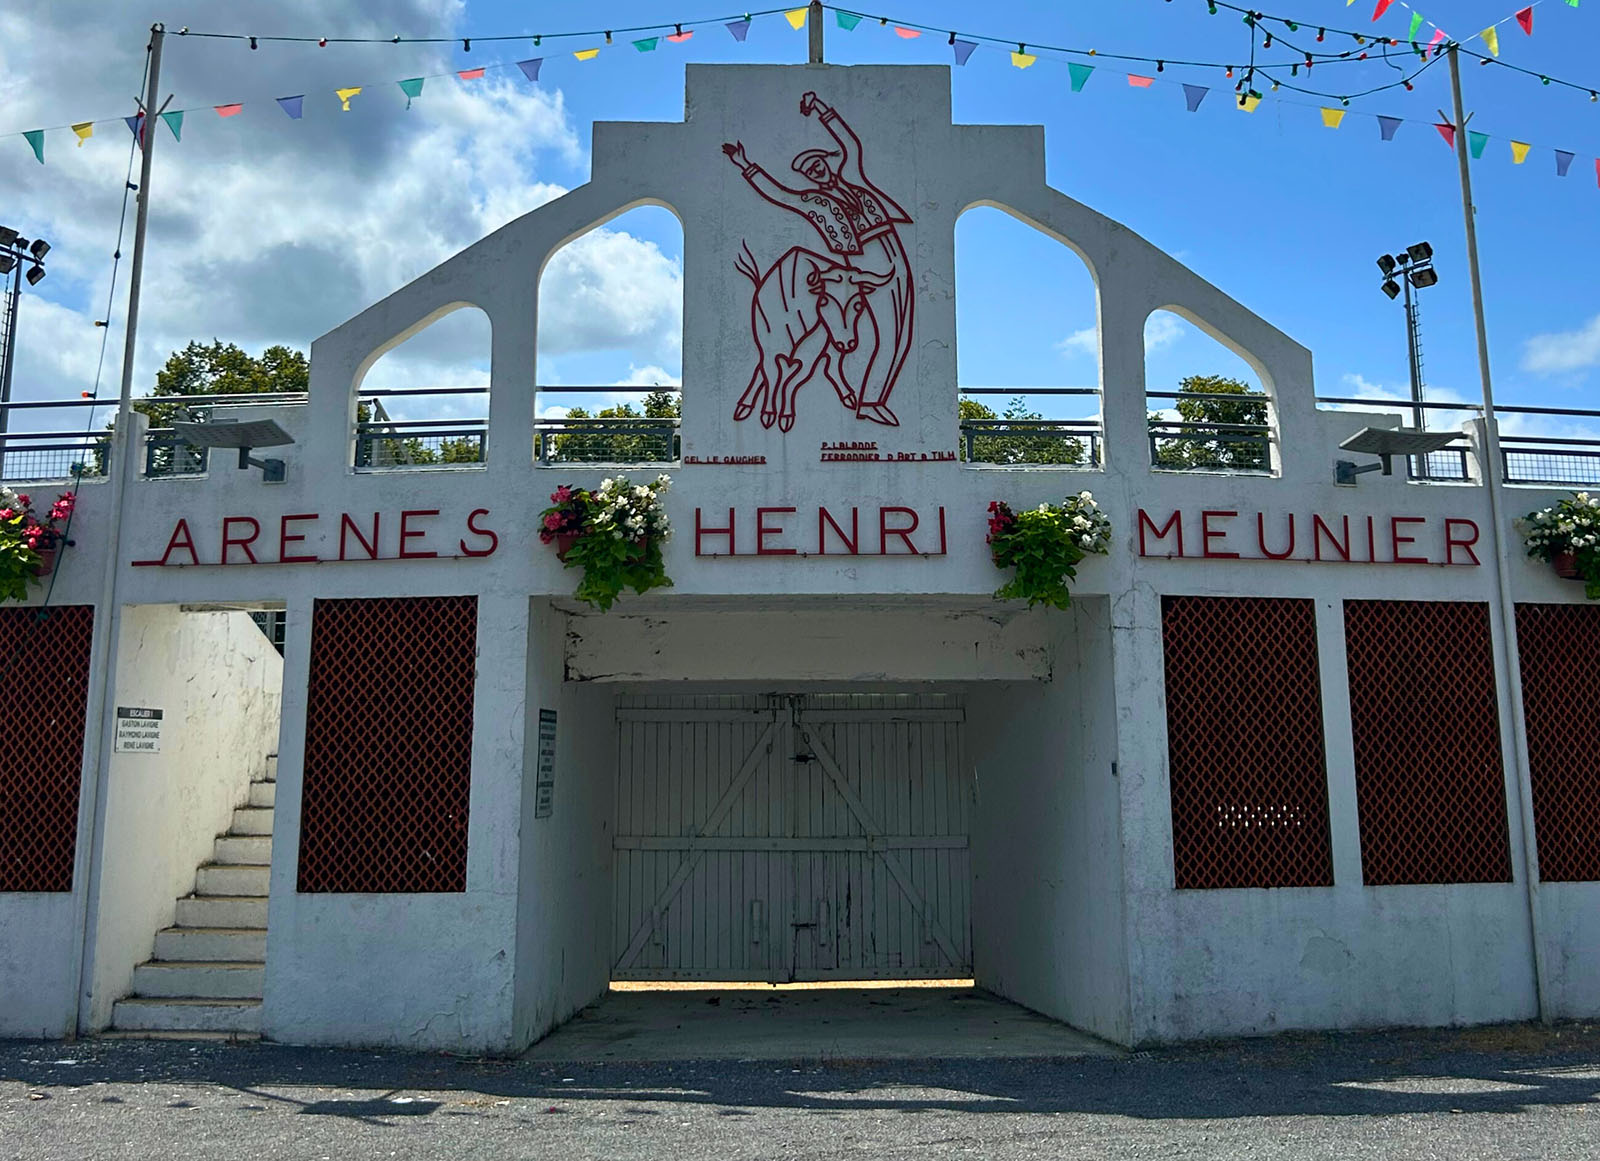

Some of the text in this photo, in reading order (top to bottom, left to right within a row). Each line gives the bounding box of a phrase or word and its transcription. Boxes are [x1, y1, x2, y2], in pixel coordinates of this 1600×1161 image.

[706, 455, 719, 464] LE
[131, 506, 1481, 566] ARENES HENRI MEUNIER
[122, 719, 159, 729] GASTON LAVIGNE
[119, 730, 160, 739] RAYMOND LAVIGNE
[136, 741, 154, 750] LAVIGNE
